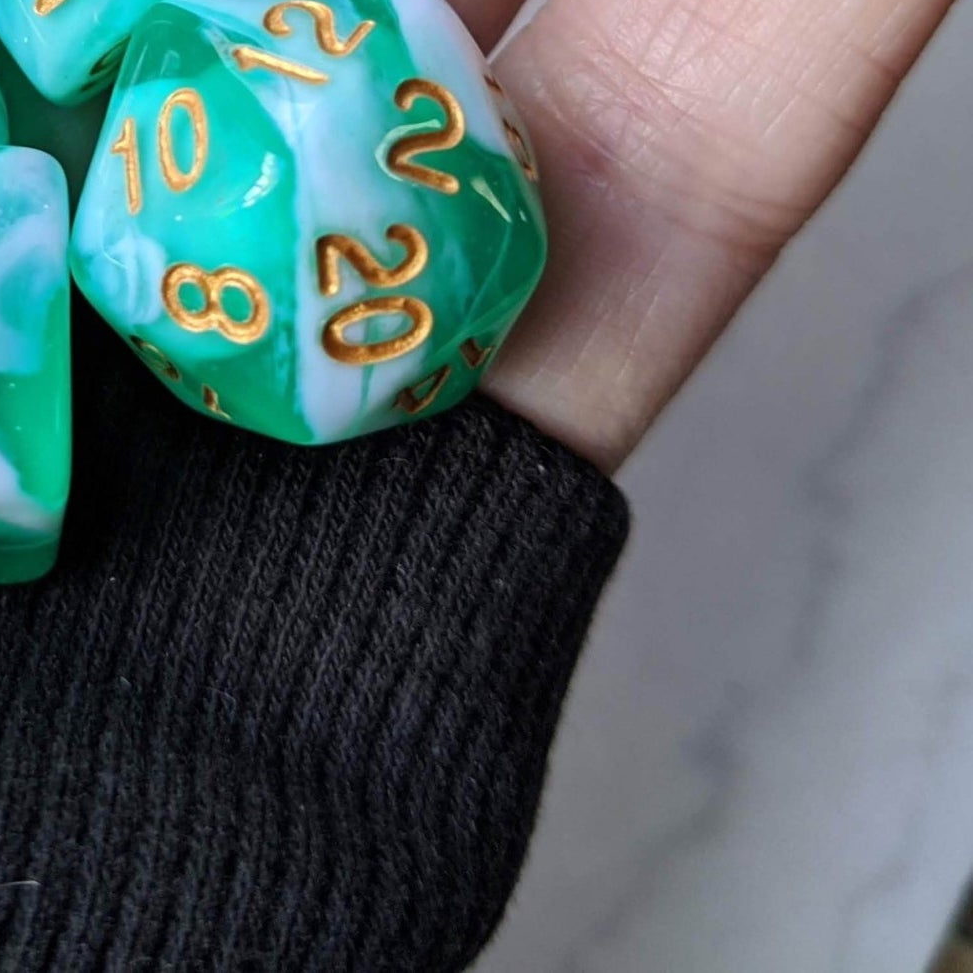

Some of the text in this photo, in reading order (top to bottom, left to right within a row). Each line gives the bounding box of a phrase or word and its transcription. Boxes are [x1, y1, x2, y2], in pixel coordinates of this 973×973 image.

[232, 0, 376, 86] 12
[111, 87, 210, 214] 10
[385, 78, 465, 196] 2
[161, 263, 270, 346] 8
[316, 224, 434, 366] 20
